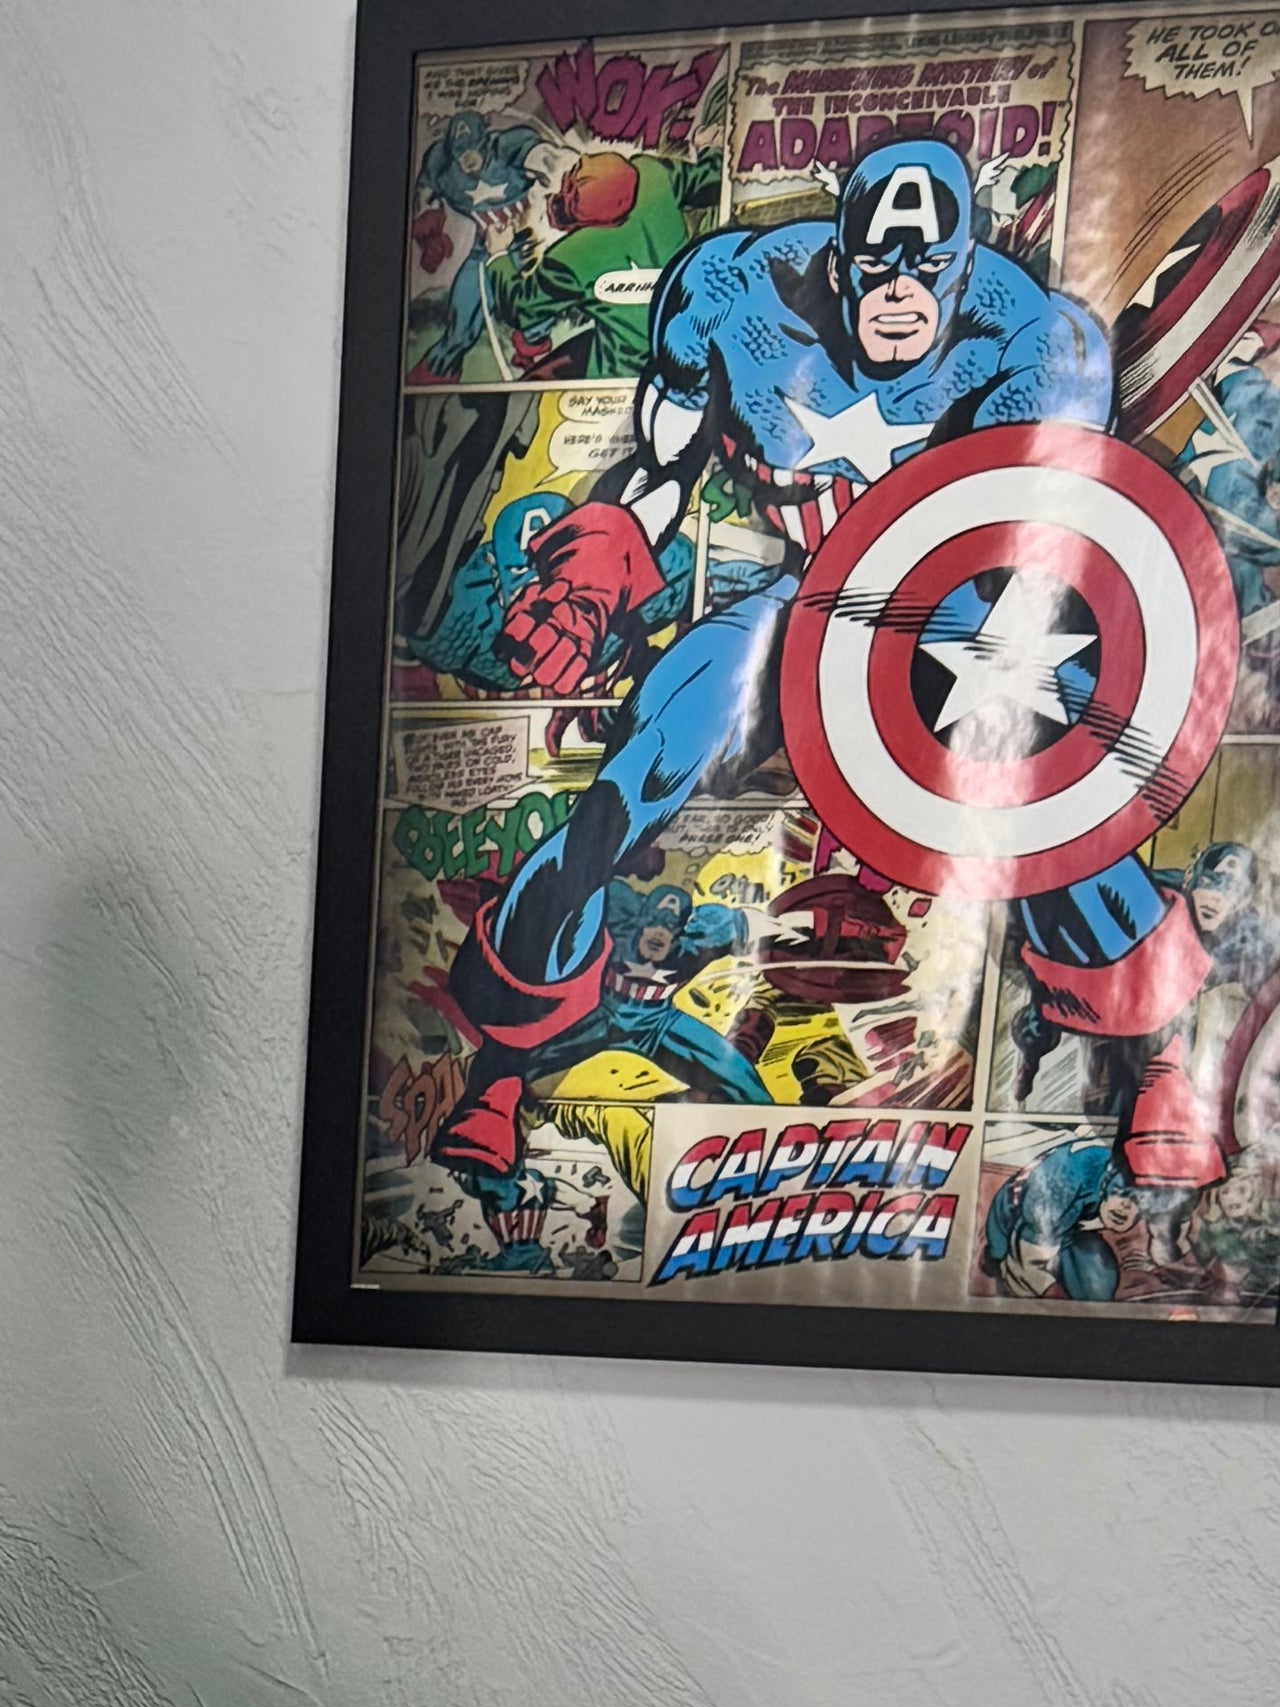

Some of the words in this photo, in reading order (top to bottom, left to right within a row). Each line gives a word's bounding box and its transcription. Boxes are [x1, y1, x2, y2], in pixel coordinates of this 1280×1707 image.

[1146, 25, 1182, 44] HE
[1190, 21, 1255, 40] TOOK
[1260, 20, 1280, 36] O
[1154, 42, 1209, 62] ALL
[1222, 39, 1259, 57] OF
[536, 42, 730, 150] WOK!
[1174, 56, 1251, 80] THEM!
[666, 1118, 974, 1213] CAPTAIN
[647, 1190, 960, 1287] AMERICA
